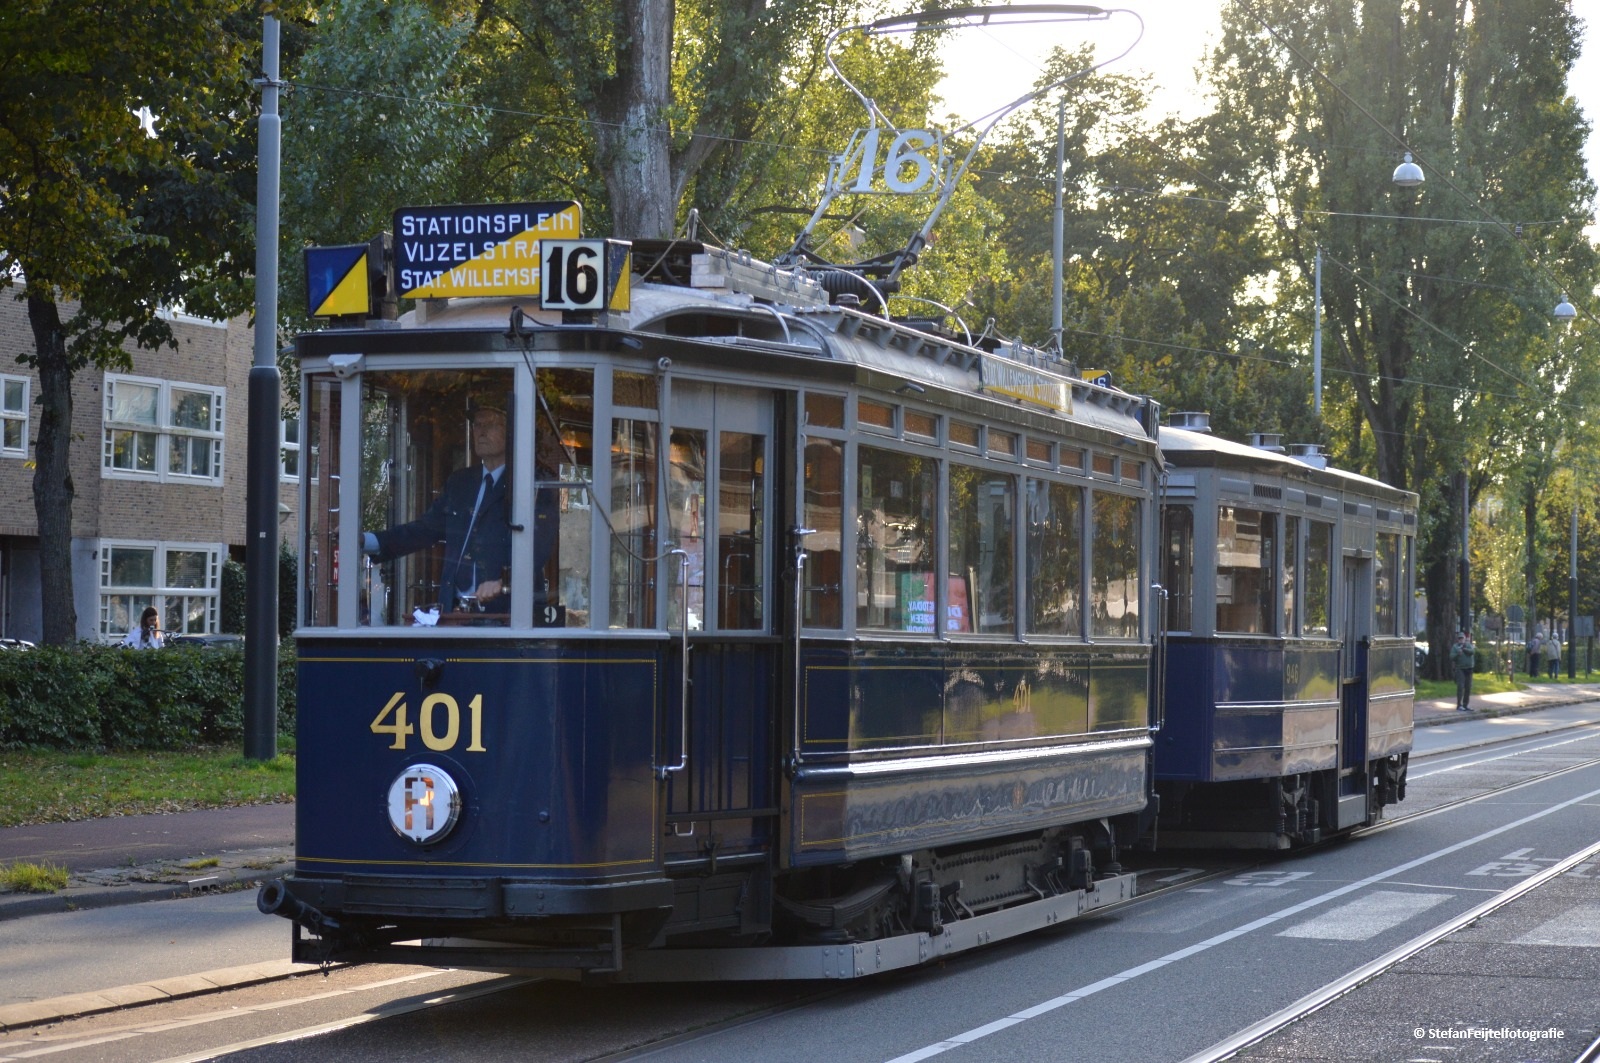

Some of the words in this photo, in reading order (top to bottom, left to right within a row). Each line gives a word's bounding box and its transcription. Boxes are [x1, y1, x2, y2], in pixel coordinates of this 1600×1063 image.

[850, 128, 935, 193] 16
[401, 212, 573, 237] STATIONSPLEIN
[401, 268, 446, 290] STAT.
[545, 246, 598, 305] 16
[543, 606, 557, 624] 9
[1012, 683, 1031, 713] 401
[370, 691, 487, 752] 401
[404, 777, 435, 831] R
